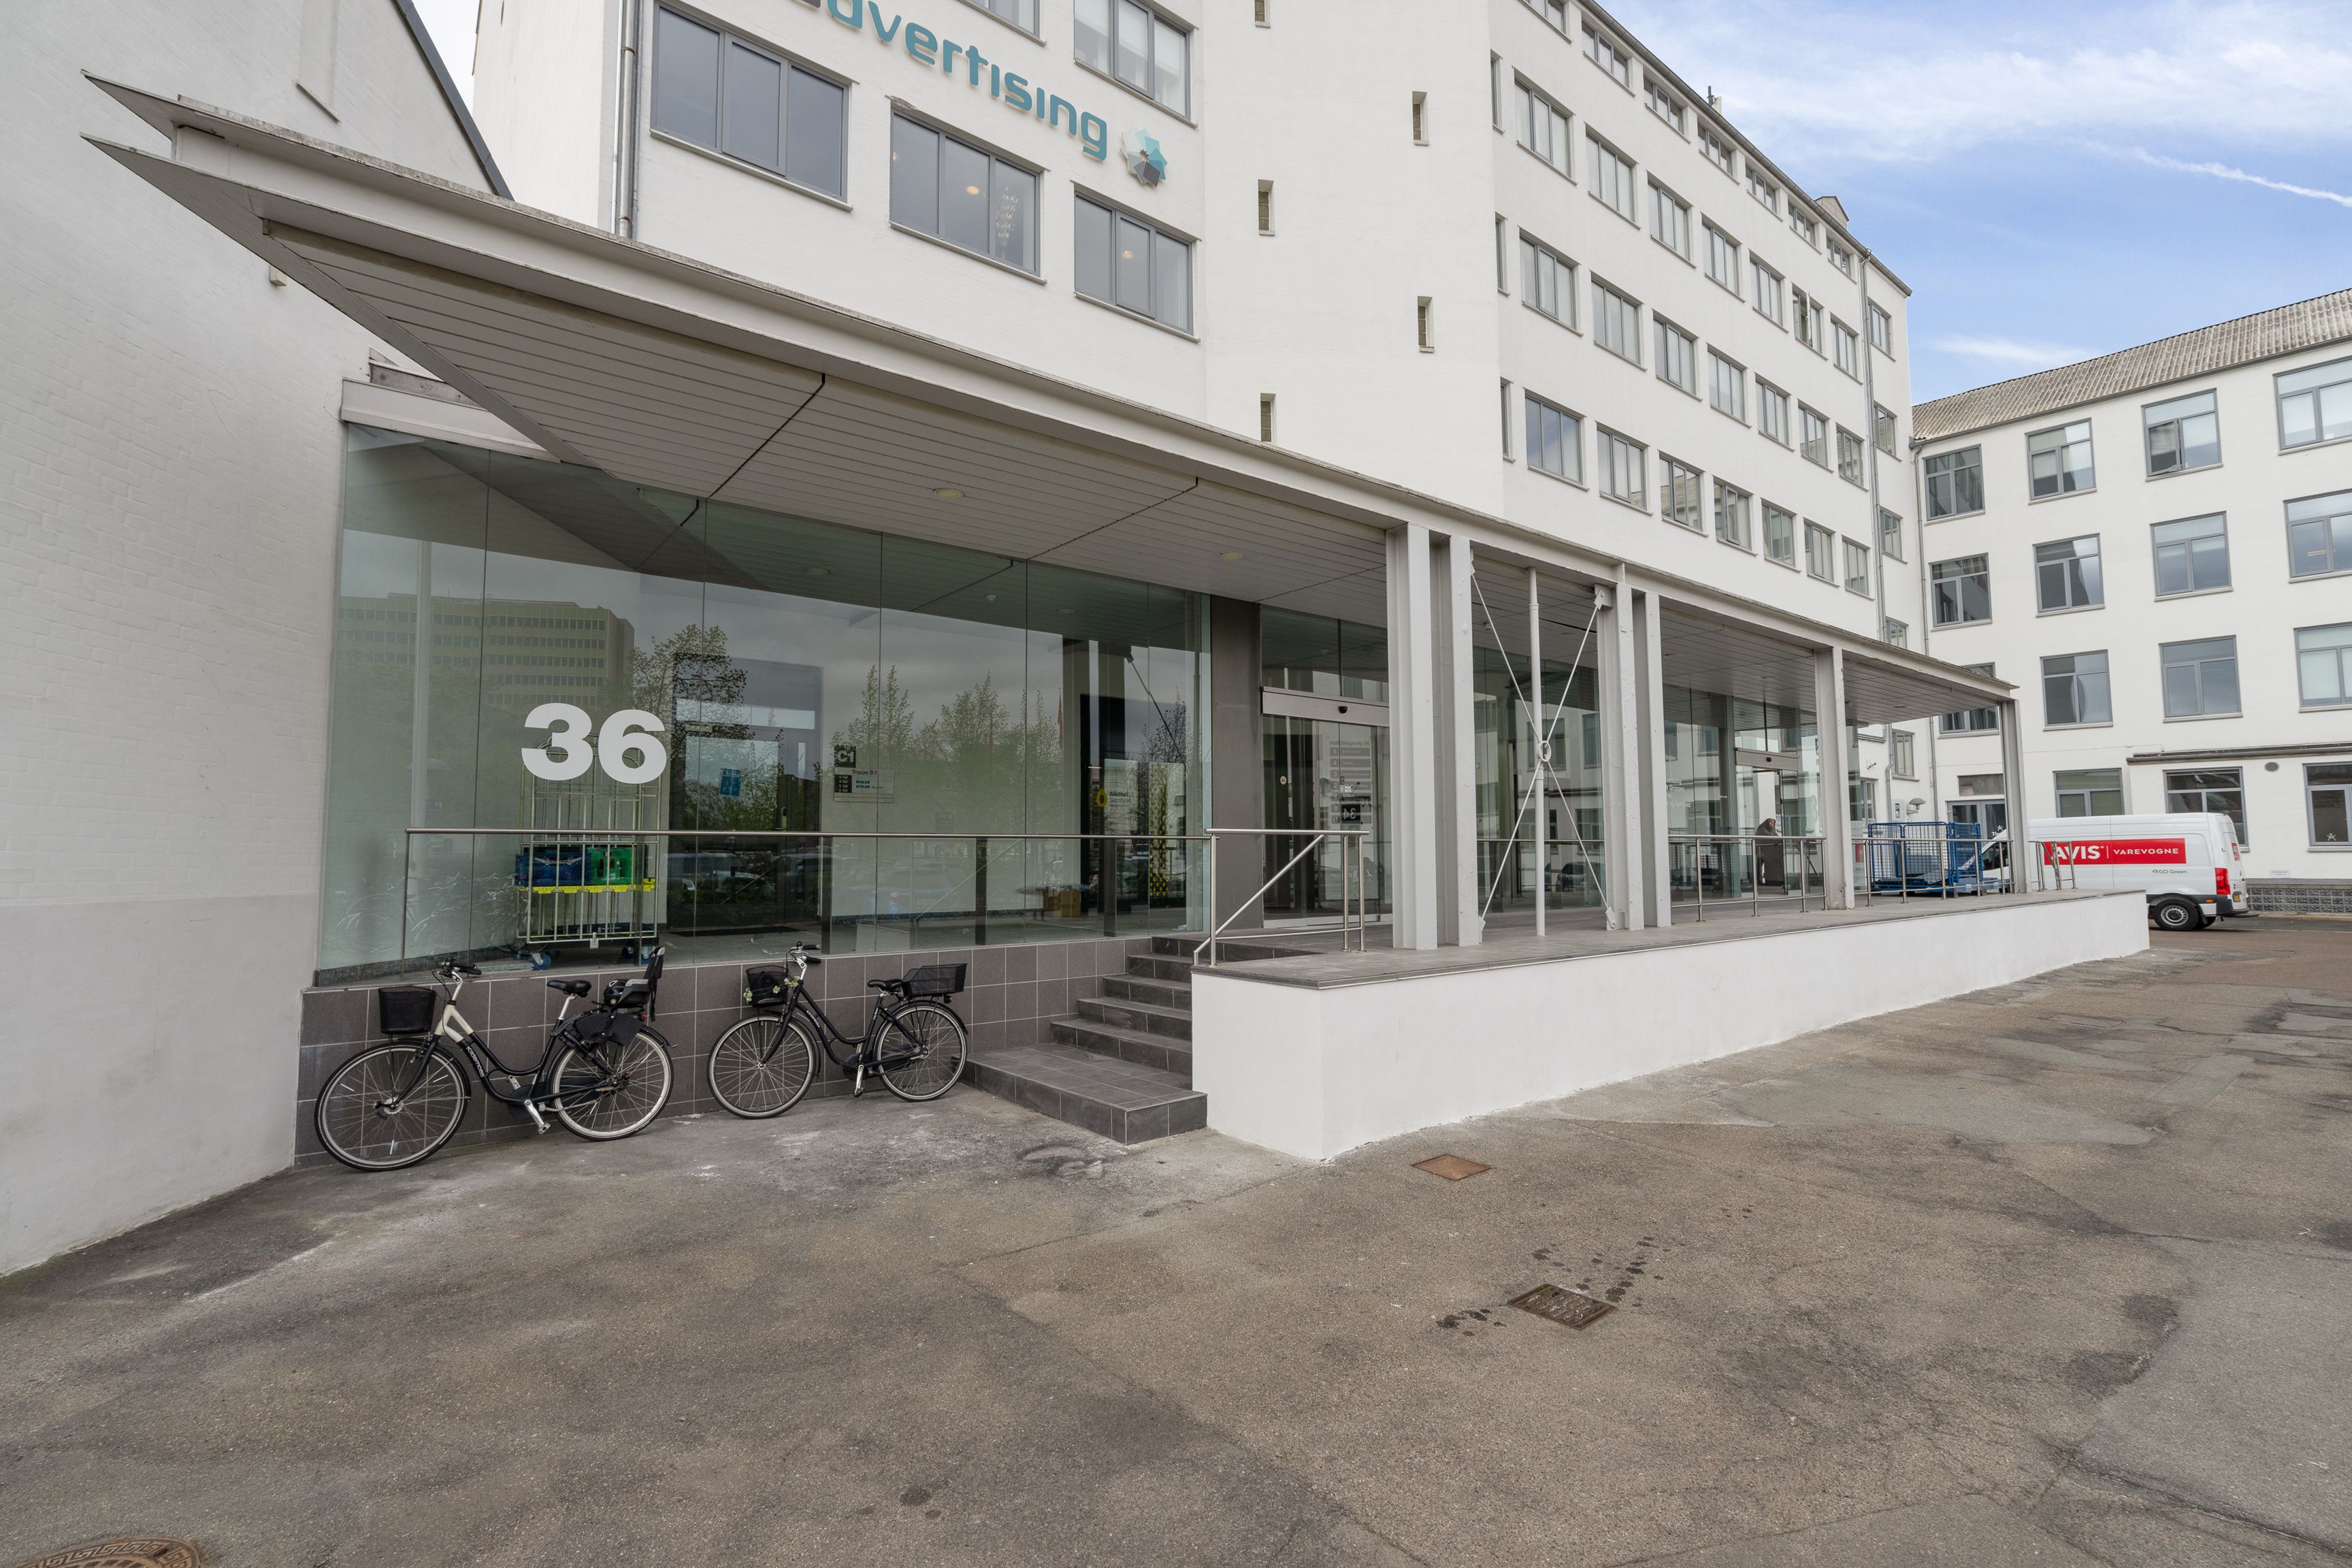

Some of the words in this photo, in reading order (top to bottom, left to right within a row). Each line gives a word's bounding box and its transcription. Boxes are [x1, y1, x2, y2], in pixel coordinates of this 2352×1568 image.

[521, 702, 667, 784] 36
[837, 751, 854, 762] C1
[2051, 845, 2100, 860] AVIS
[466, 1046, 485, 1077] Kildemoes
